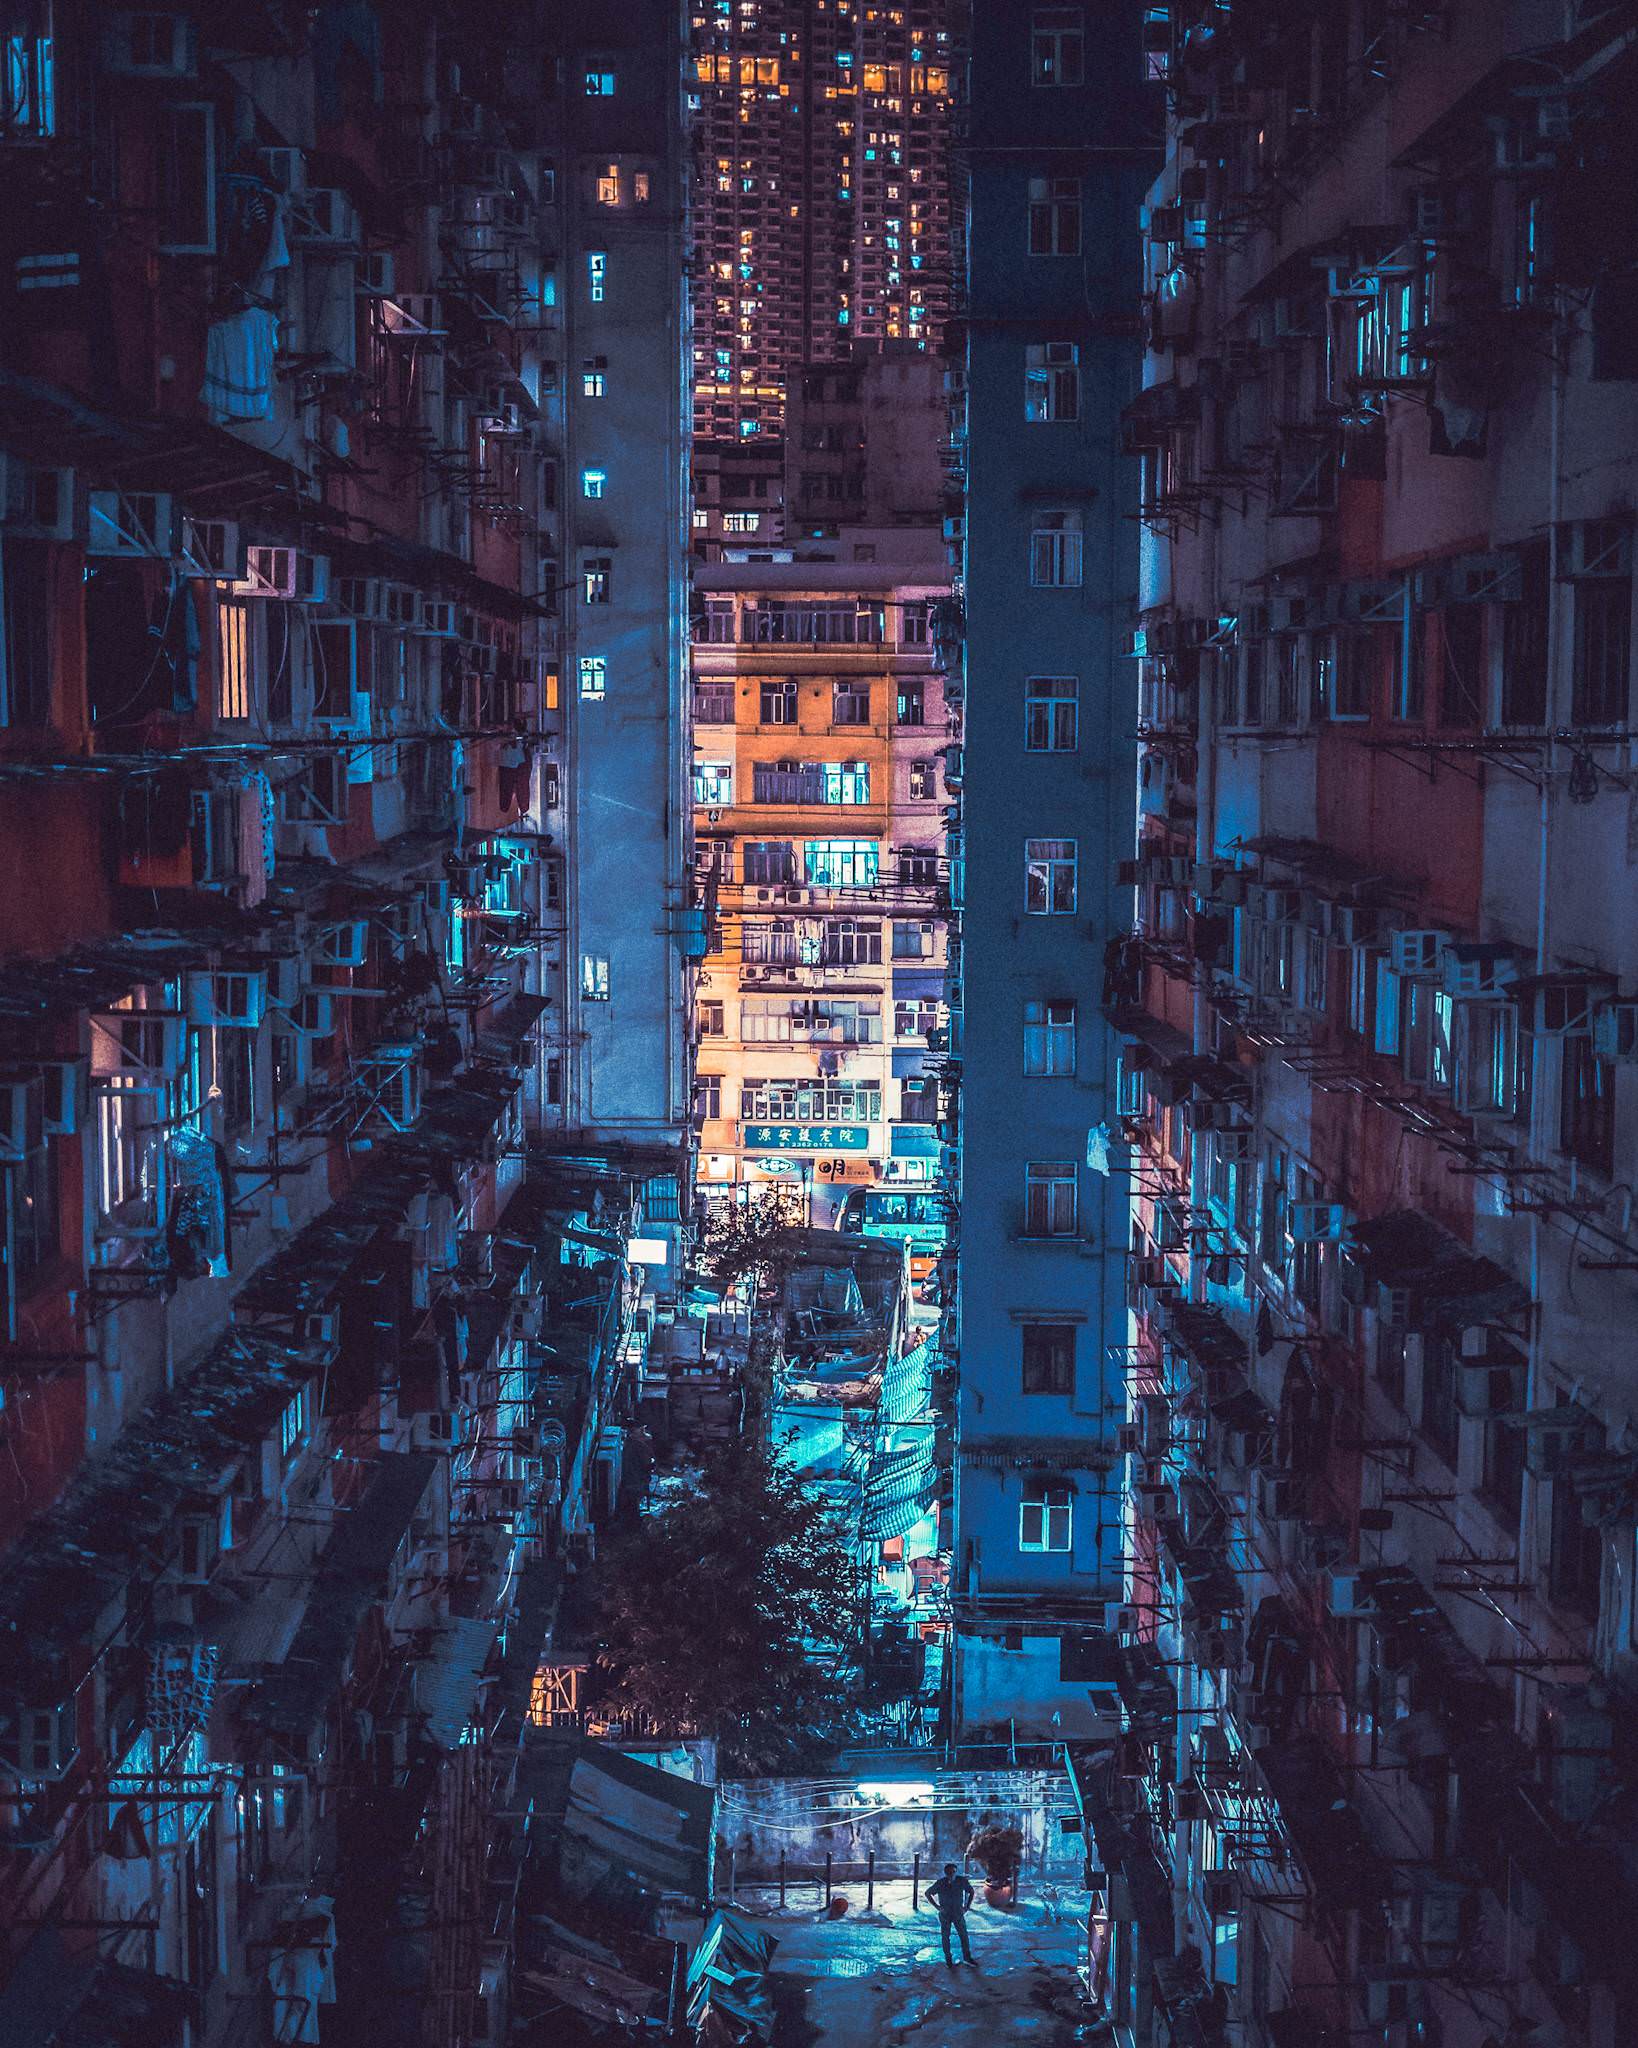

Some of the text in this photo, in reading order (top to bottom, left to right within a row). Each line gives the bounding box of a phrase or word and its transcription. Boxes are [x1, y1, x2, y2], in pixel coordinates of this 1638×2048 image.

[758, 1127, 854, 1142] 源安護老院
